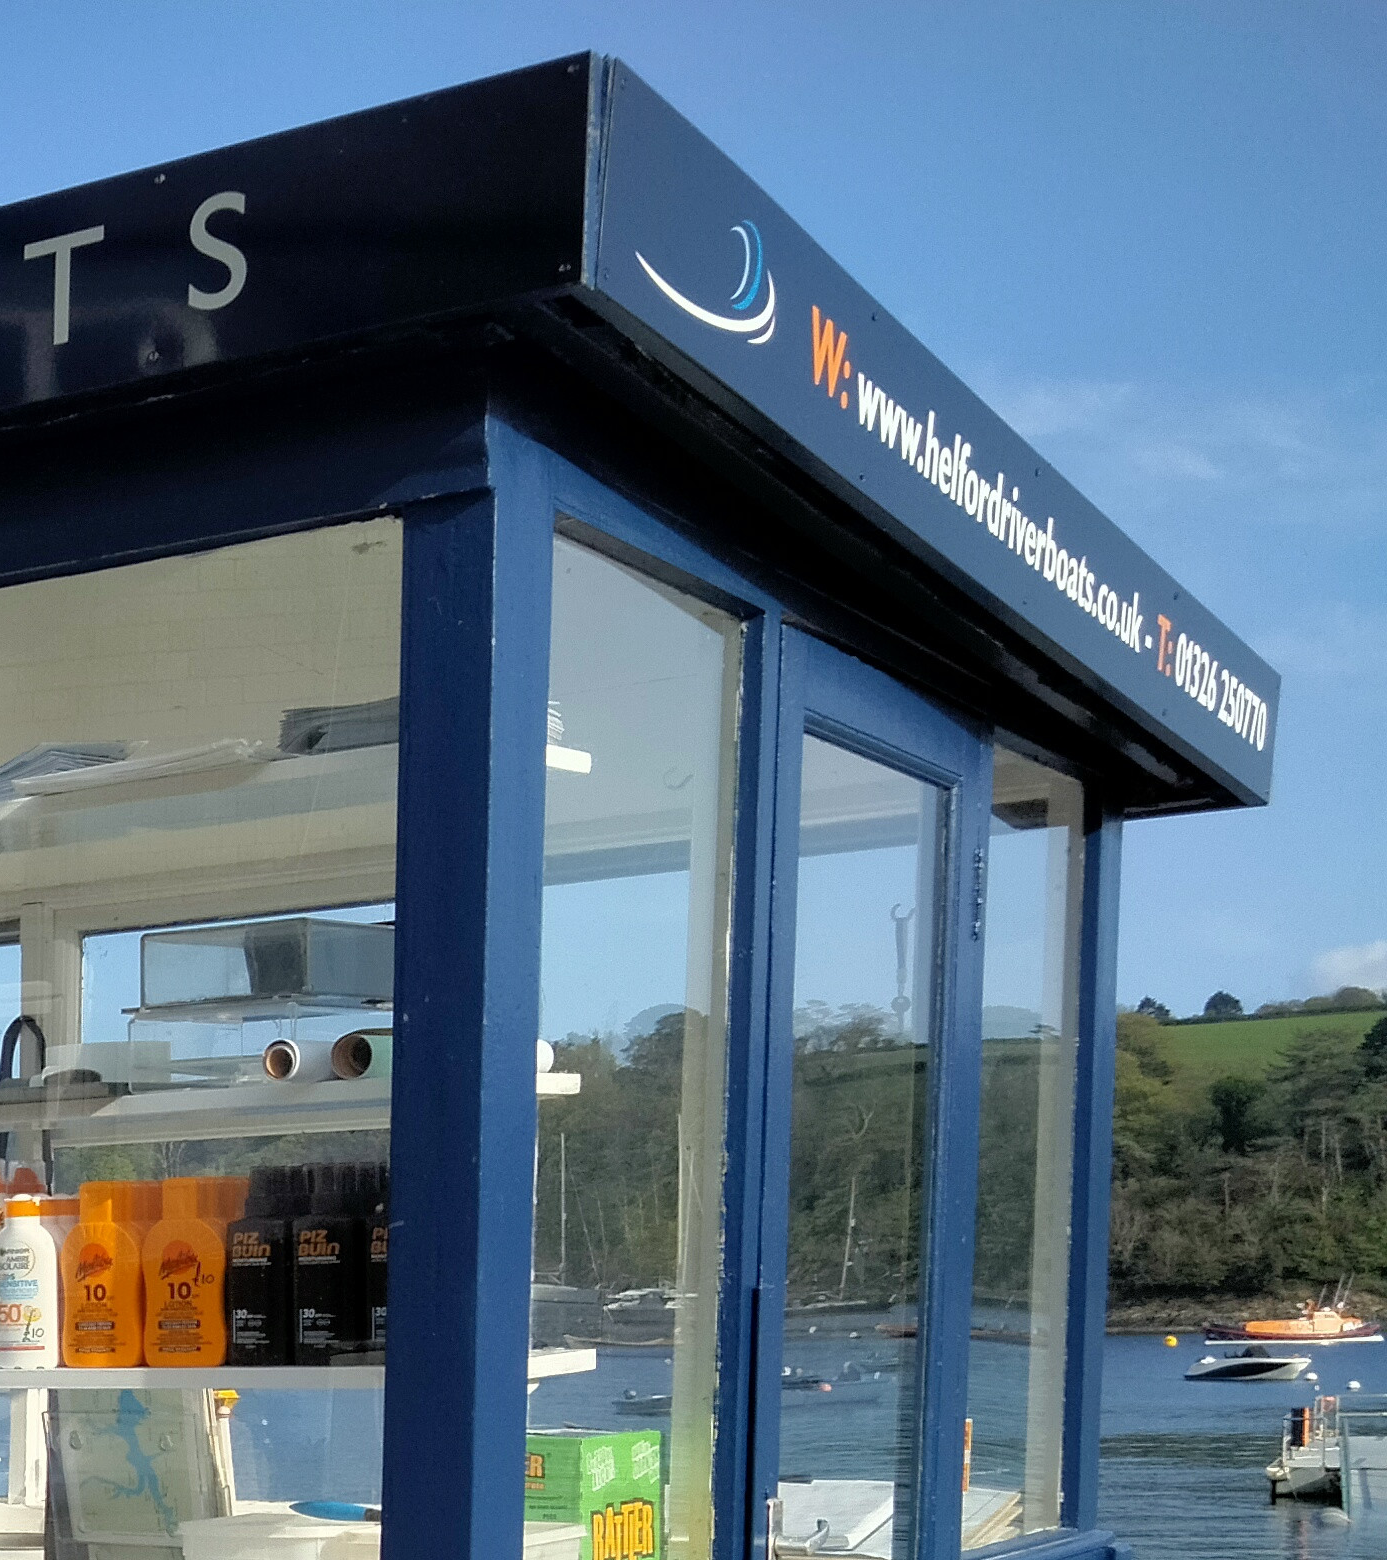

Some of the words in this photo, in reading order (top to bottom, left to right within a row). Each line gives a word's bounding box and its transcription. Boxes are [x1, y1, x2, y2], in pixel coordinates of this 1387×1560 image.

[812, 304, 852, 411] W:
[857, 371, 1143, 654] www.helfordriverboats.co.uk
[1156, 613, 1174, 678] T:
[1174, 632, 1218, 713] 01326
[1219, 668, 1270, 753] 250770
[84, 1284, 107, 1301] 10
[167, 1281, 192, 1300] 10
